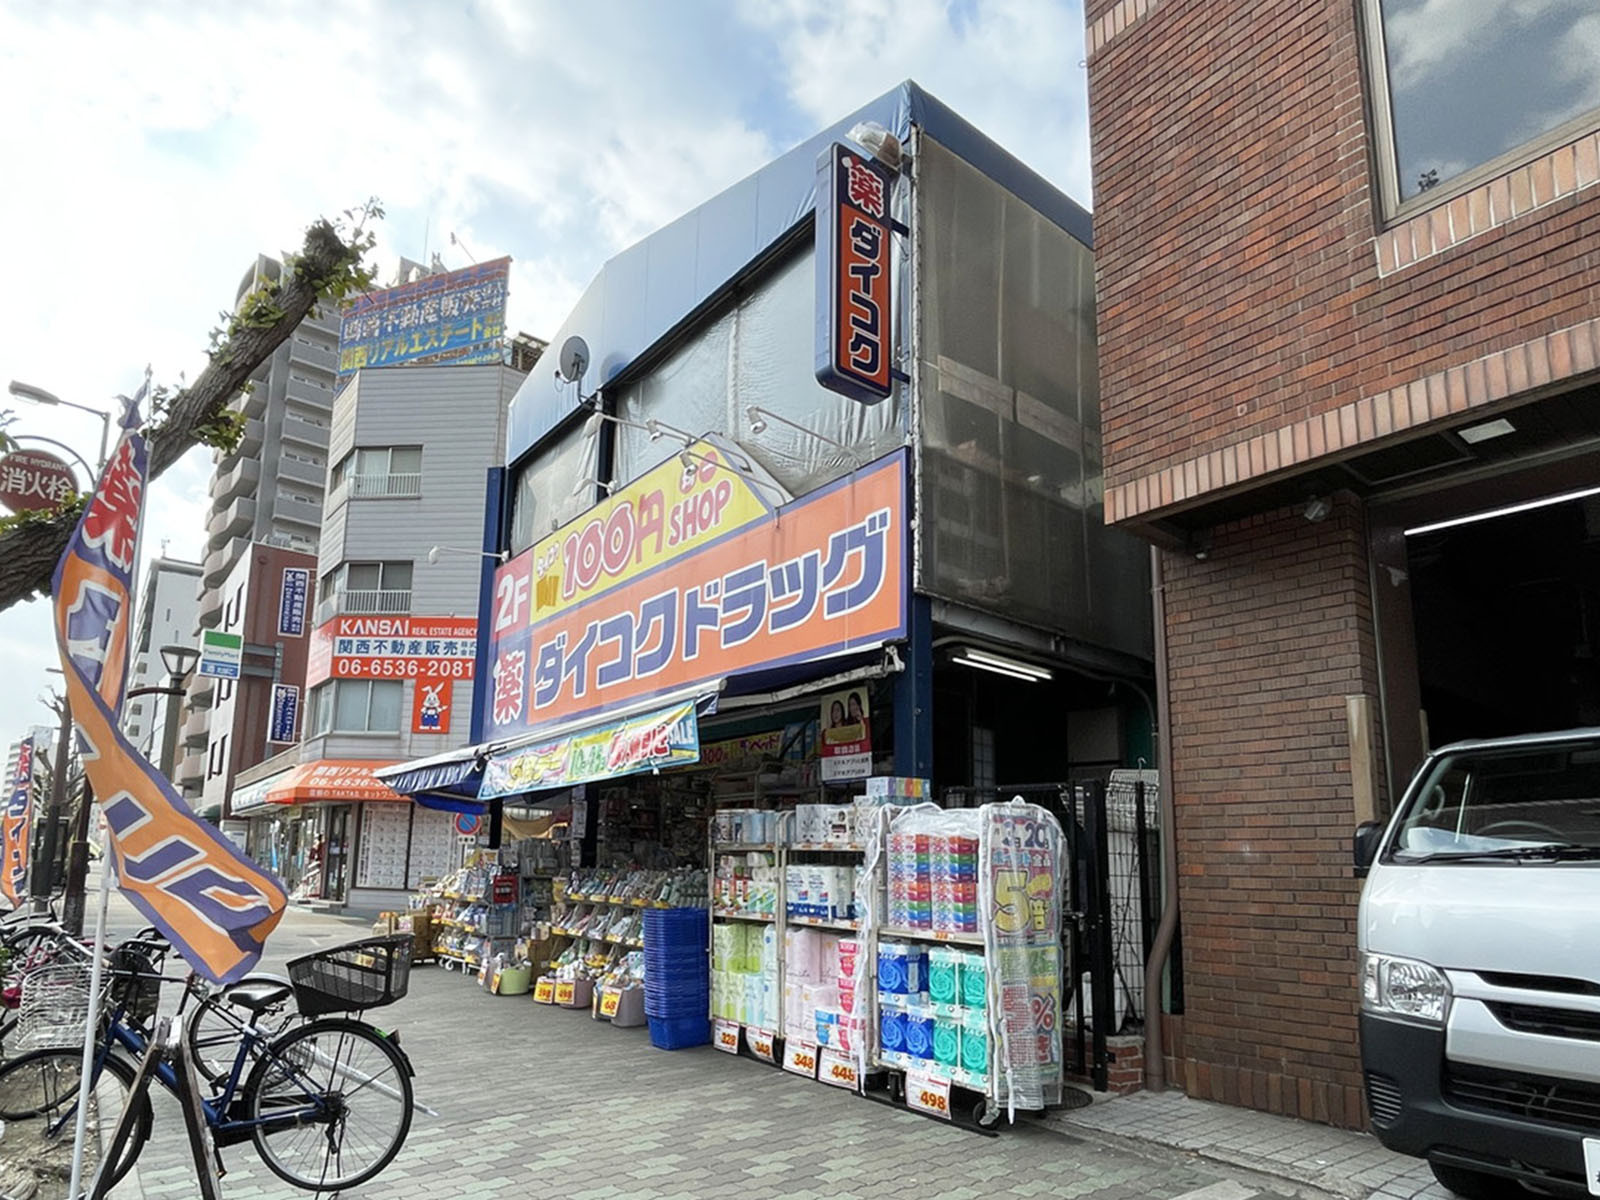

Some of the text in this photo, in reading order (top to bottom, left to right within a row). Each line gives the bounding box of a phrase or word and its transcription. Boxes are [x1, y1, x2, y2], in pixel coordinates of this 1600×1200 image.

[847, 156, 884, 219] 薬
[850, 217, 882, 376] ダイコク
[9, 454, 67, 471] FIRE HYDRANT
[0, 465, 74, 503] 消火栓
[82, 437, 143, 571] 薬
[562, 479, 732, 602] 100円 SHOP
[495, 574, 529, 632] 2F
[534, 507, 891, 709] ダイコクドラッグ
[340, 619, 477, 637] KANSAI REAL ESTATE AGENCY
[337, 639, 458, 656] 関西不動産販売
[338, 659, 474, 677] 06-6536-2081
[493, 650, 526, 726] 薬
[312, 766, 377, 777] 関西リアル
[604, 1000, 617, 1010] 68
[794, 1053, 814, 1070] 348
[920, 1091, 946, 1110] 498
